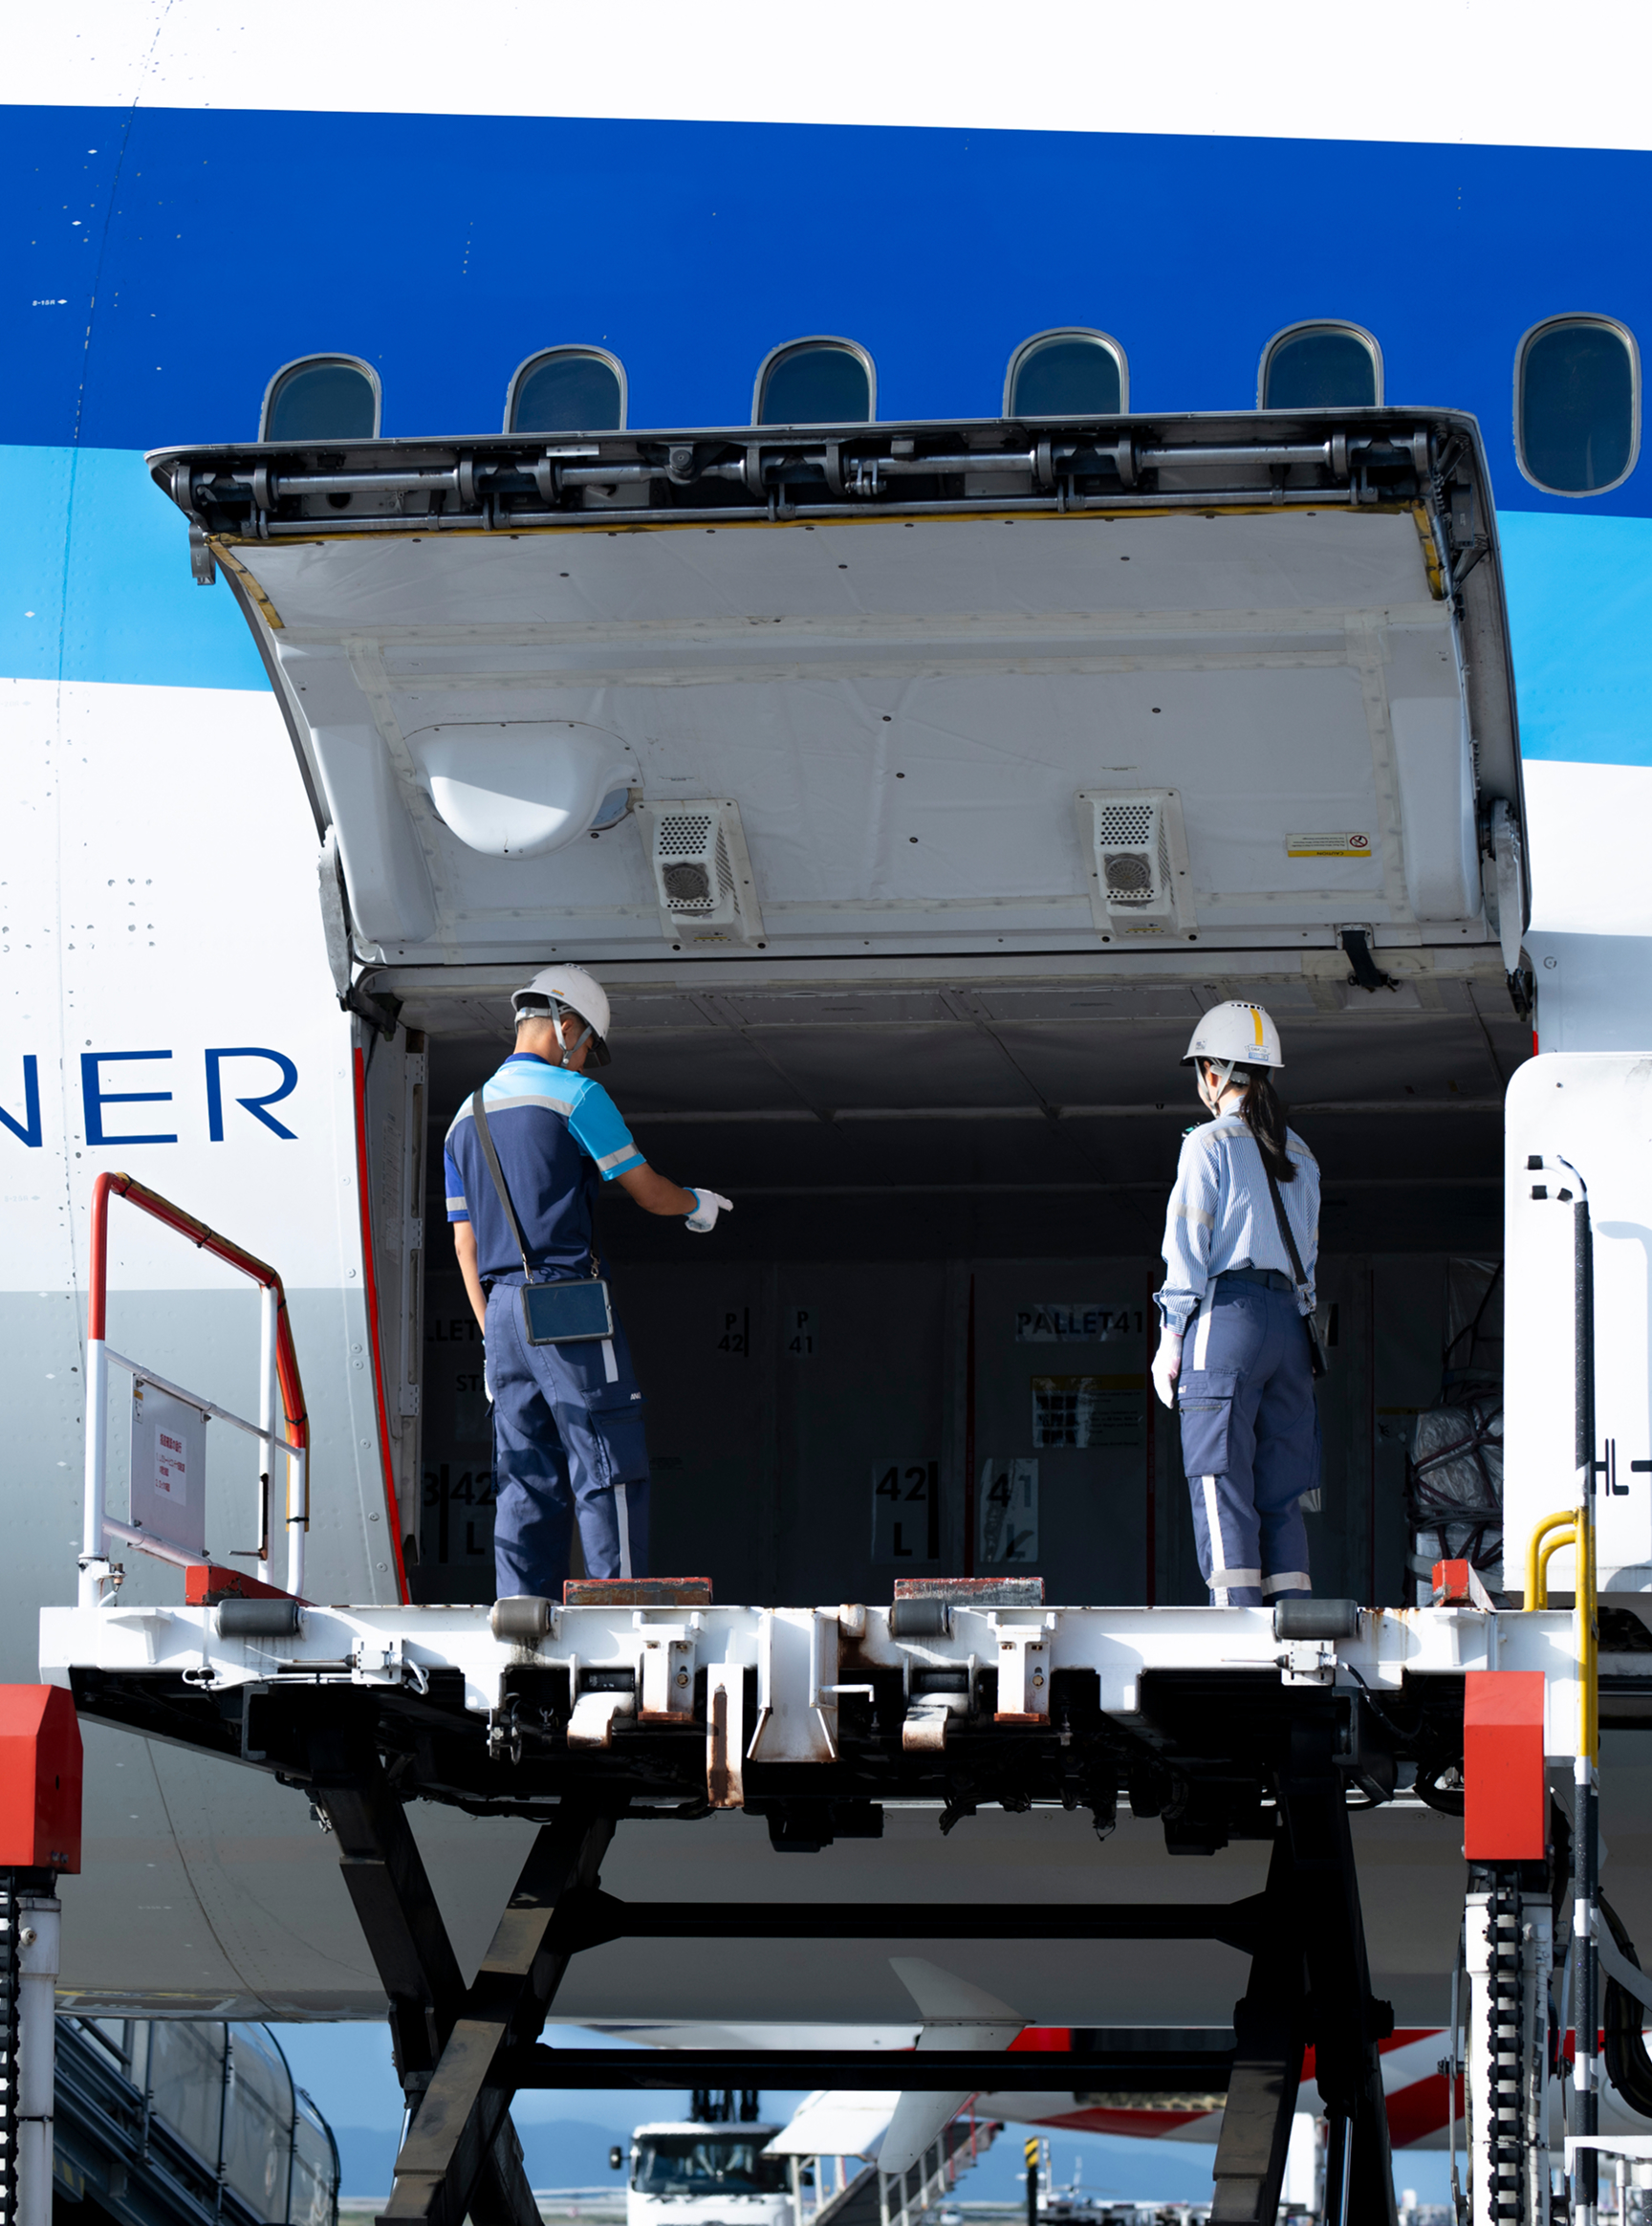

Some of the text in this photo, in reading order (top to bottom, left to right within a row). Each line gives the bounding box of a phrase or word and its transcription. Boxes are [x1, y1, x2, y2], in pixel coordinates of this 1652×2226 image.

[726, 1313, 737, 1330] P
[797, 1311, 808, 1328] P
[717, 1334, 744, 1352] 42
[789, 1336, 812, 1353] 41
[456, 1374, 485, 1392] ST
[450, 1472, 496, 1506] 42
[876, 1467, 926, 1501] 42
[987, 1473, 1032, 1508] 41
[467, 1521, 486, 1555] L
[894, 1522, 913, 1557] L
